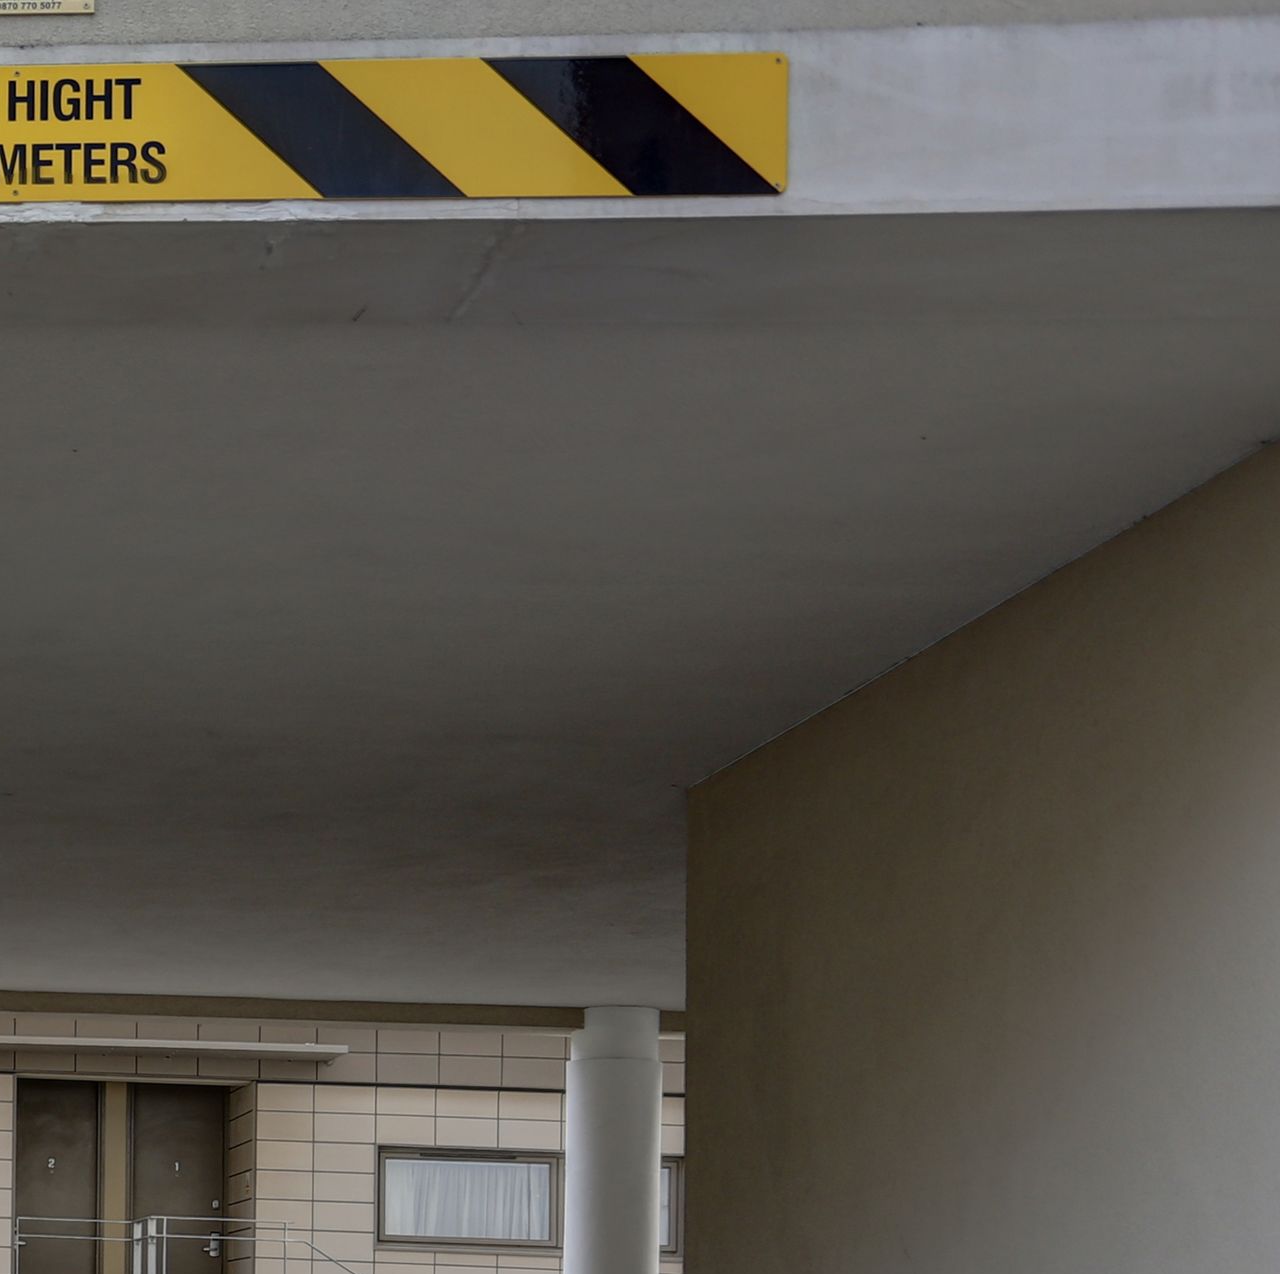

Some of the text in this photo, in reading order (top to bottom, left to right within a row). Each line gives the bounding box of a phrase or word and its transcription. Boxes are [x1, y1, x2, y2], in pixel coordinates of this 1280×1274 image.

[21, 2, 38, 10] 770
[40, 1, 62, 10] 5077
[7, 78, 142, 121] HIGHT
[47, 1158, 56, 1169] 2
[174, 1161, 180, 1172] 1
